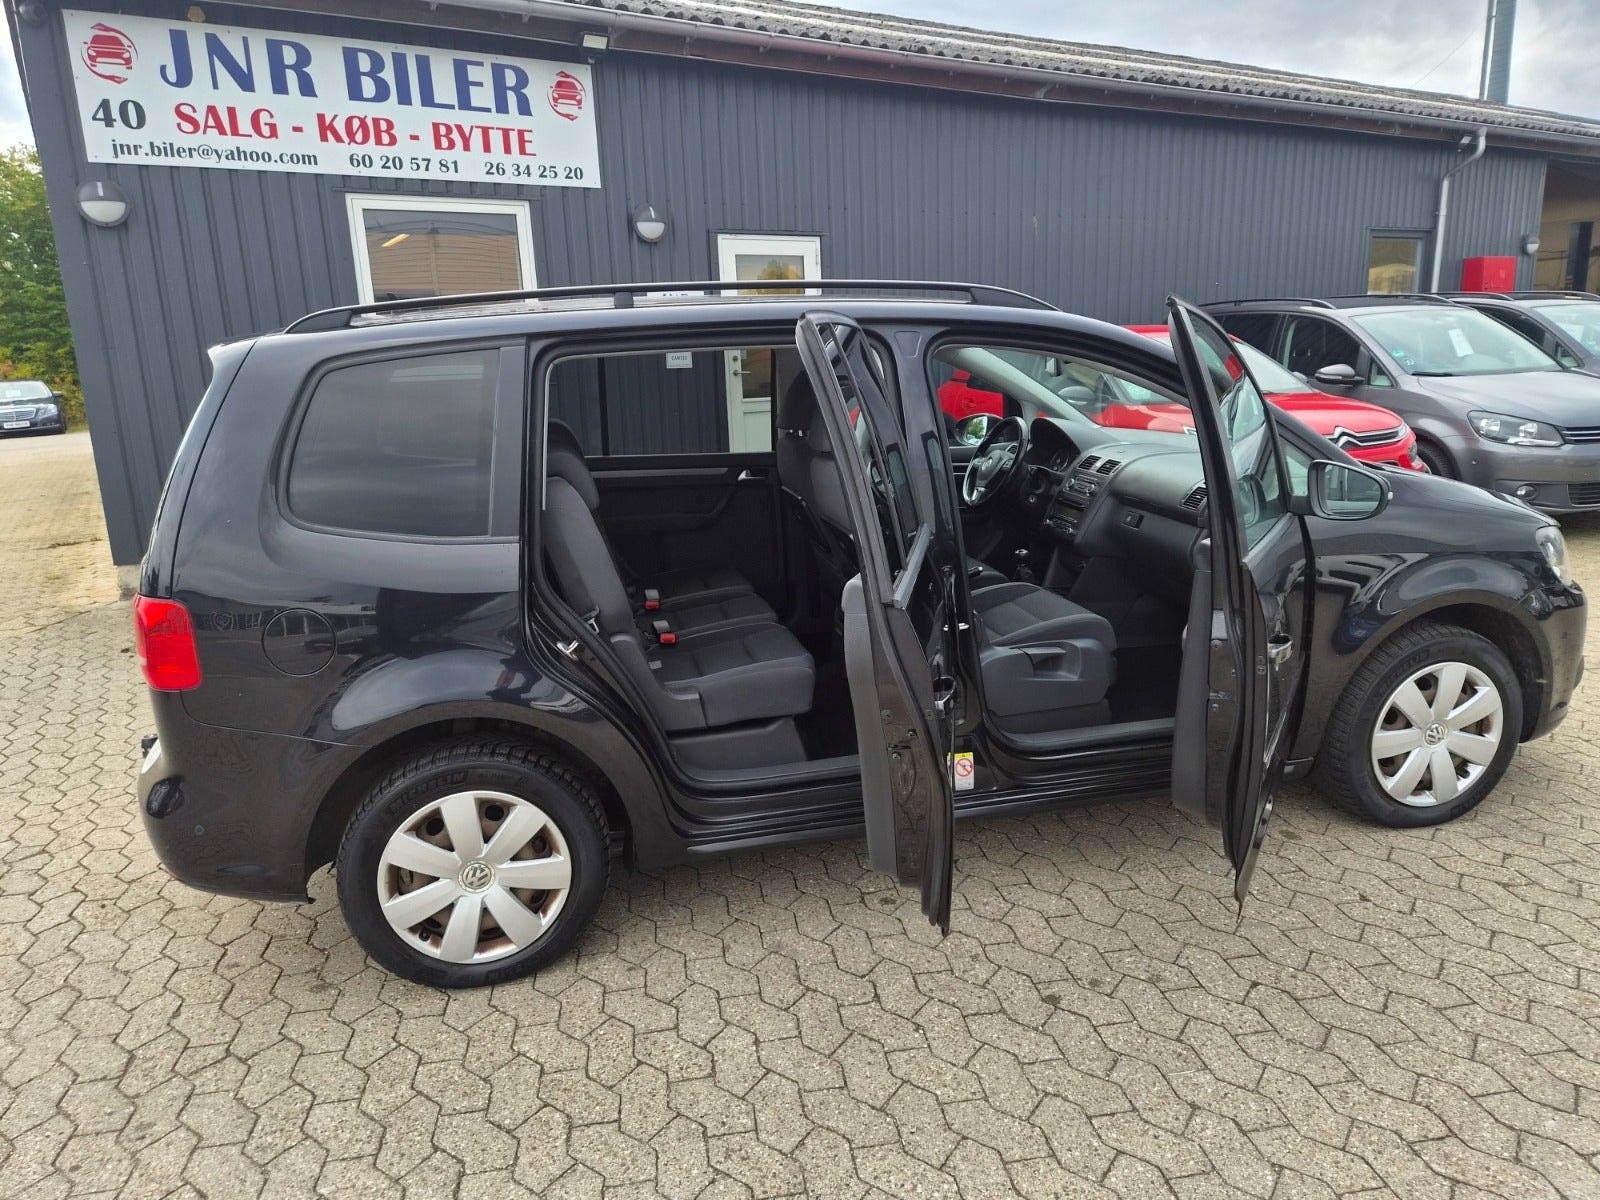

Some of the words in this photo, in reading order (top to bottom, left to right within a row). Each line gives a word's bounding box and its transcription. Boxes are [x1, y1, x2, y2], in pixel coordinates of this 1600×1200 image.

[160, 28, 318, 98] JNR
[342, 46, 533, 117] BILER
[91, 98, 147, 130] 40
[174, 102, 279, 140] SALG
[316, 112, 398, 146] KØB
[431, 121, 537, 157] BYTTE
[111, 139, 319, 167] jnr.biler@yahoo.com
[349, 153, 374, 169] 60
[380, 154, 404, 171] 20
[410, 157, 432, 172] 57
[439, 159, 460, 174] 81
[485, 161, 506, 177] 26
[512, 163, 532, 178] 34
[538, 164, 558, 179] 25
[564, 166, 584, 181] 20
